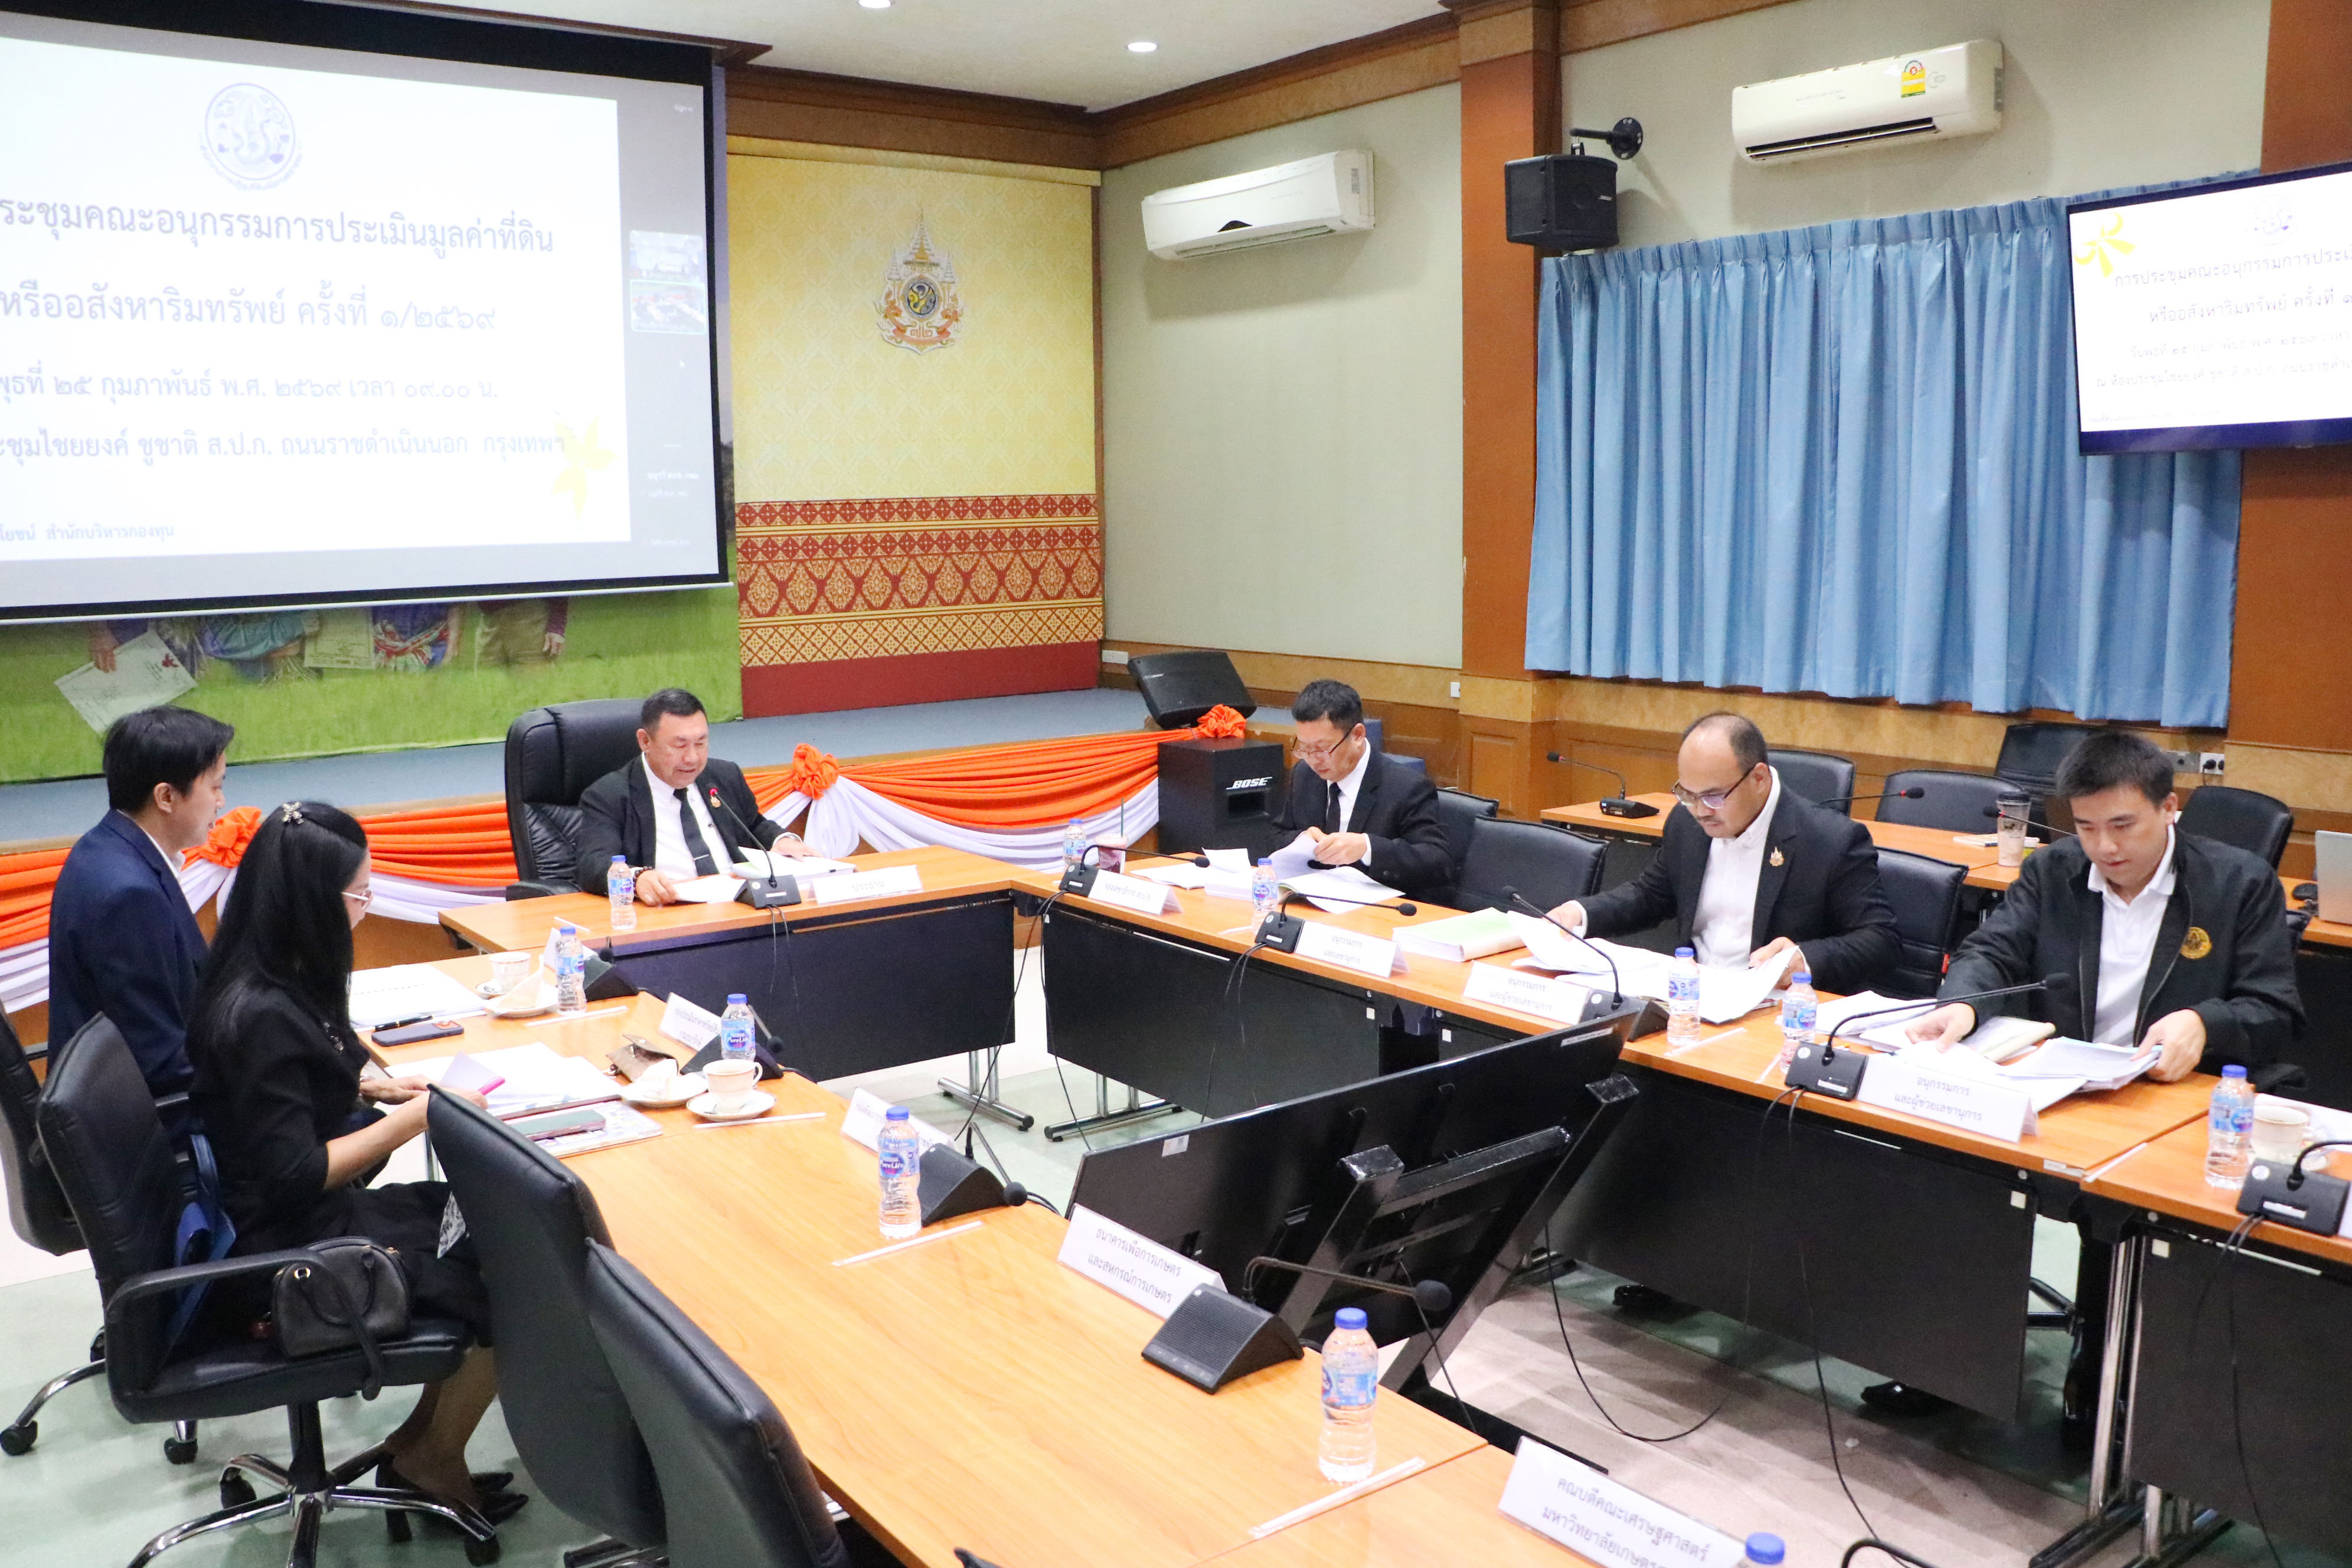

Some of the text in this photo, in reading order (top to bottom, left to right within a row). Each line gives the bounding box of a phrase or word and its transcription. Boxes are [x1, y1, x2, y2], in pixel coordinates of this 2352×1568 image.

[2115, 243, 2352, 287] การประชุมคณะอนุกรรมการประเ
[0, 279, 496, 329] หรืออสังหาริมทรัพย์ ครั้งที่ ๑/๒๕๖๙
[2149, 292, 2286, 323] หรืออสังหาริมทรัพย์
[2294, 284, 2334, 308] ครั้งที่
[2282, 357, 2352, 374] ถนนราชดำเ
[54, 374, 93, 395] ๒๕
[102, 368, 212, 404] กุมภาพันธ์
[221, 378, 266, 397] พ.ศ.
[275, 377, 341, 397] ๒๕๖๙
[349, 379, 394, 398] เวลา
[404, 383, 470, 398] ๐๙.๐๐
[478, 381, 498, 398] น.
[138, 429, 198, 466] ชูชาติ
[208, 432, 272, 456] ส.ป.ก.
[282, 428, 468, 456] ถนนราชดำเนินนอก
[484, 435, 565, 462] กรุงเทพฯ
[47, 522, 175, 542] สำนักบริหารกองทุน
[1226, 776, 1272, 790] BOSE
[852, 881, 885, 891] ประธาน
[1331, 935, 1363, 948] อนุกรรมการ
[1324, 950, 1360, 965] และเลขานุการ
[1508, 978, 1546, 992] อนุกรรมการ
[1489, 991, 1553, 1011] และผู้ช่วยเลขานุการ
[1917, 1077, 1970, 1096] อนุกรรมการ
[1894, 1093, 1982, 1121] และผู้ช่วยเลขานุการ
[1096, 1228, 1182, 1278] ธนาคารเพื่อการเกษตร
[1087, 1253, 1172, 1304] และสหกรณ์การเกษตร
[1557, 1478, 1710, 1562] คณบดีคณะเศรษฐศาสตร์
[1542, 1506, 1667, 1568] มหาวิทยาลัยเกษตร
